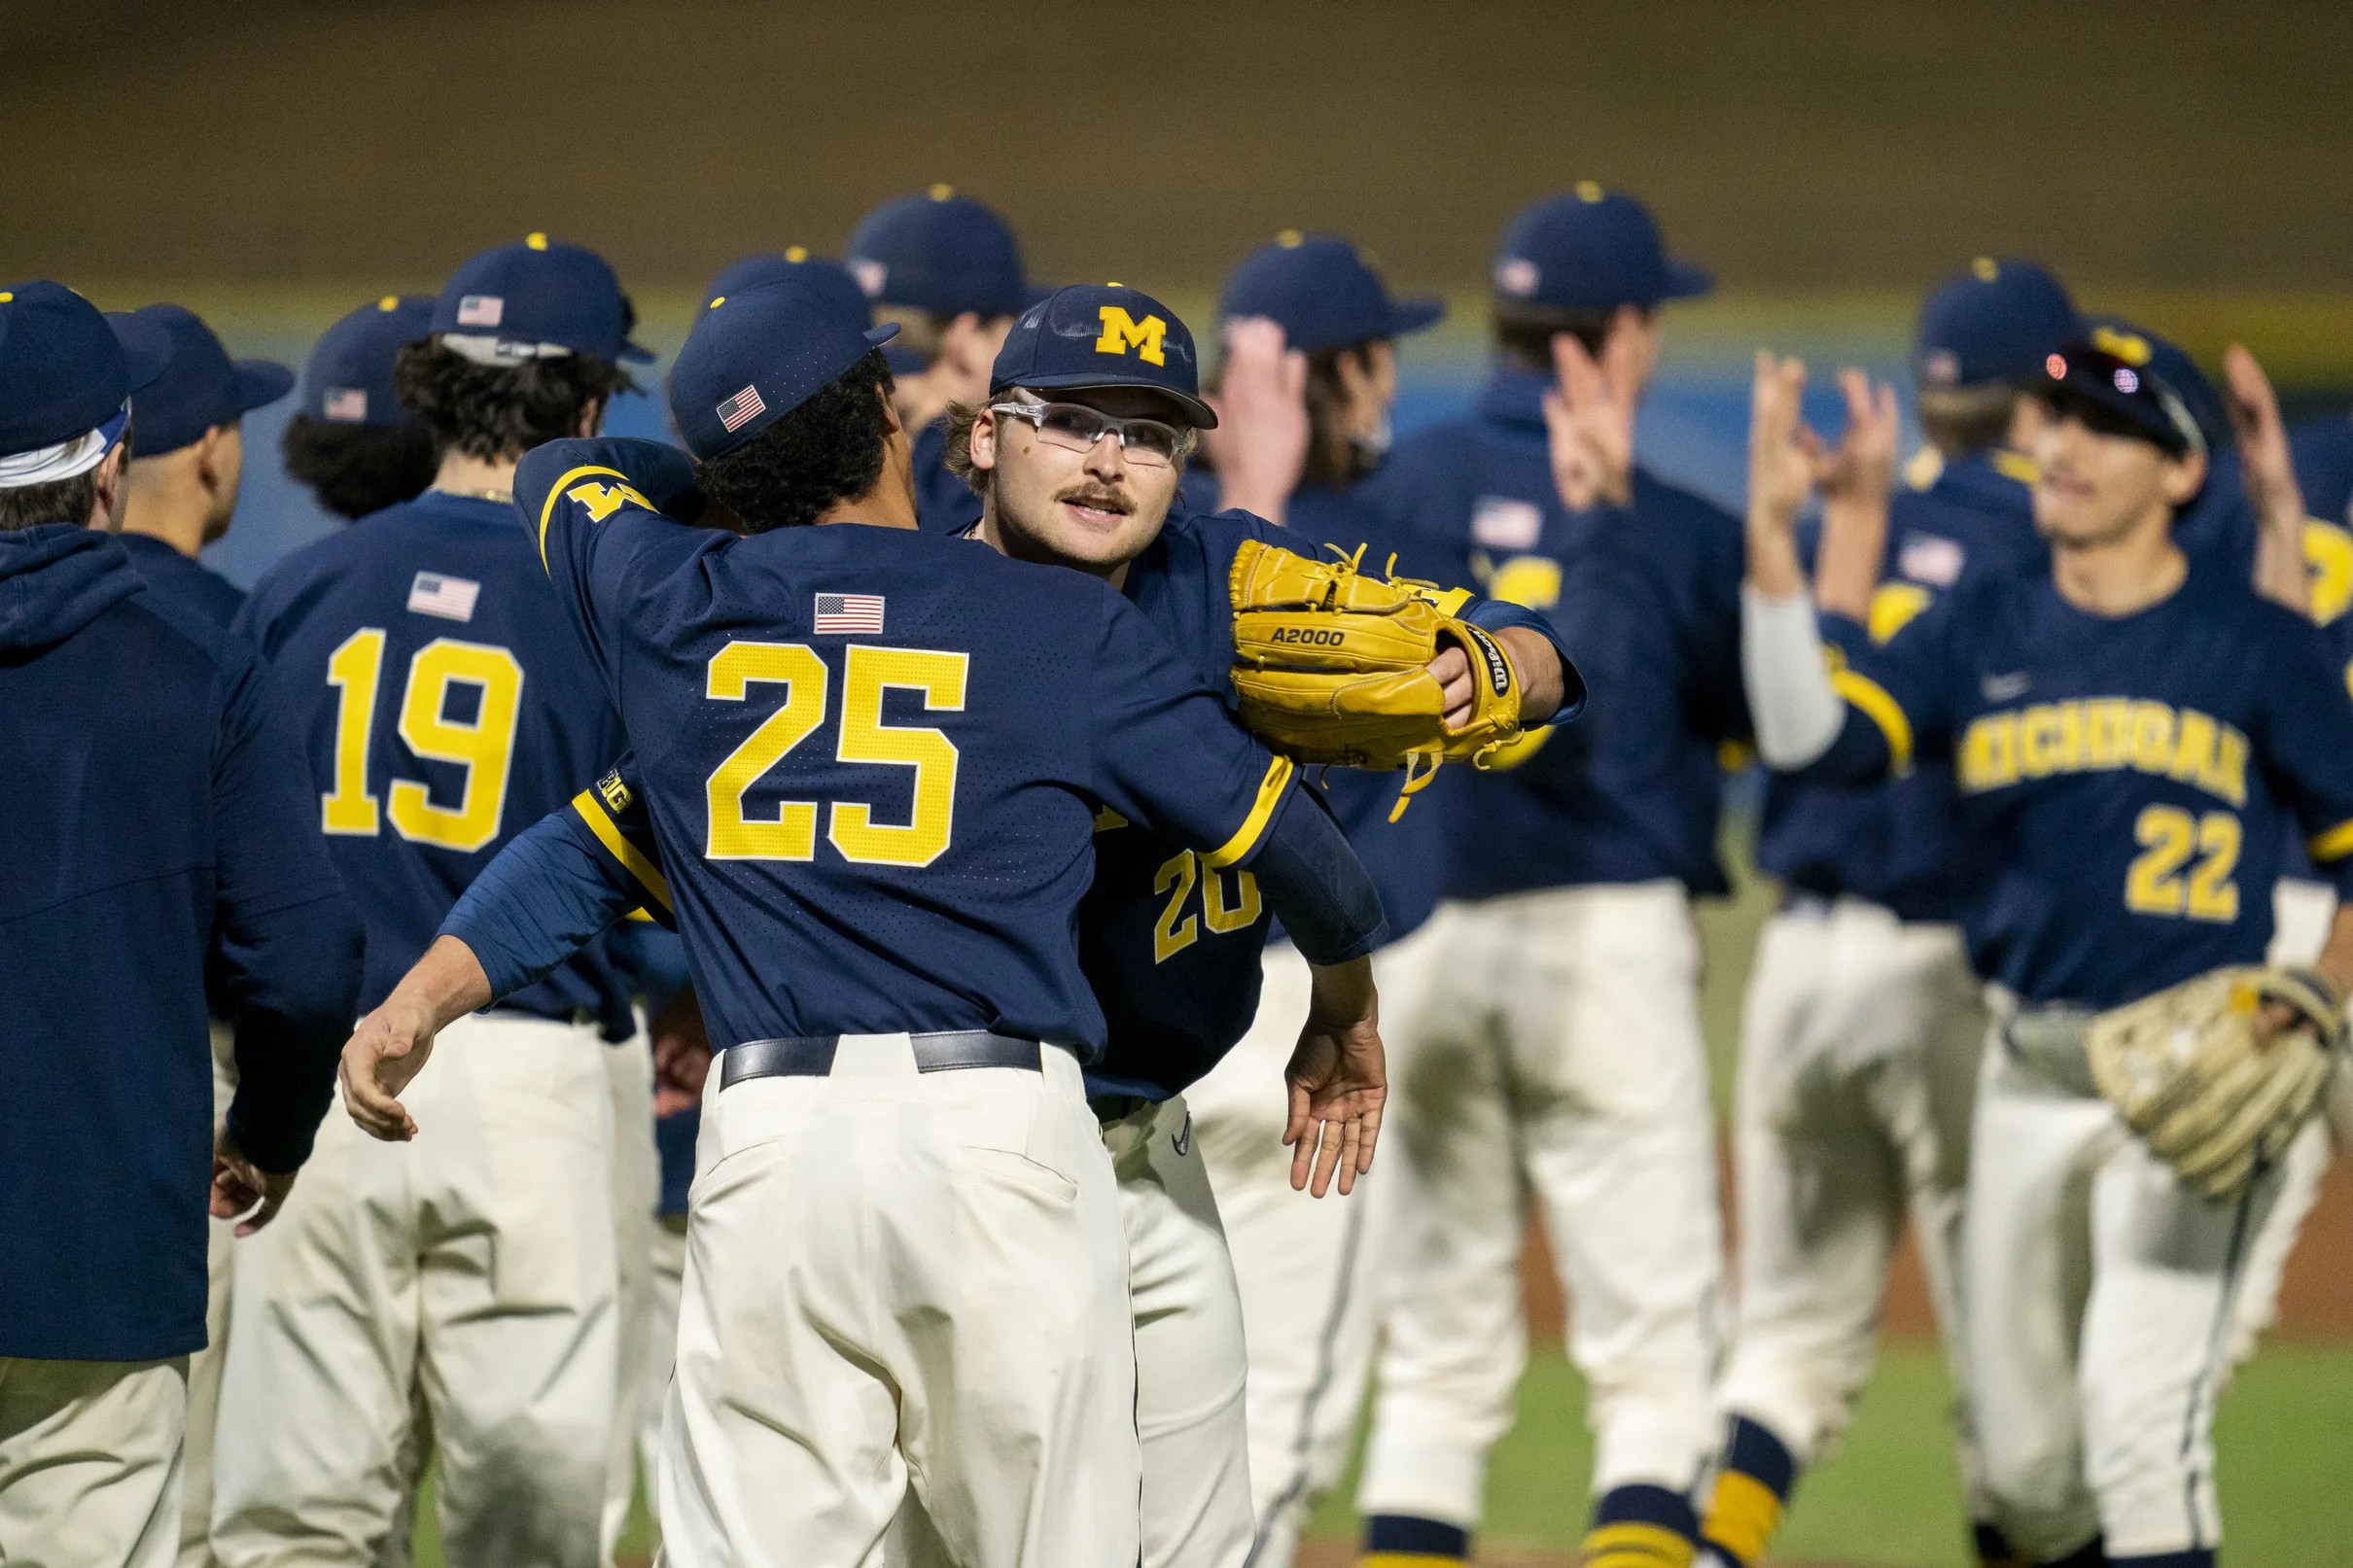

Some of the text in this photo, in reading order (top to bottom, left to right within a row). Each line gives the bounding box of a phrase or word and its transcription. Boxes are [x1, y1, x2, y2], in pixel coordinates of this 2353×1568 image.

[1095, 306, 1166, 366] M
[1271, 628, 1345, 646] A2000
[1468, 628, 1508, 689] Wilson
[323, 627, 524, 853] 19
[705, 641, 969, 867] 25
[1154, 849, 1262, 965] 20
[2125, 804, 2243, 922] 22
